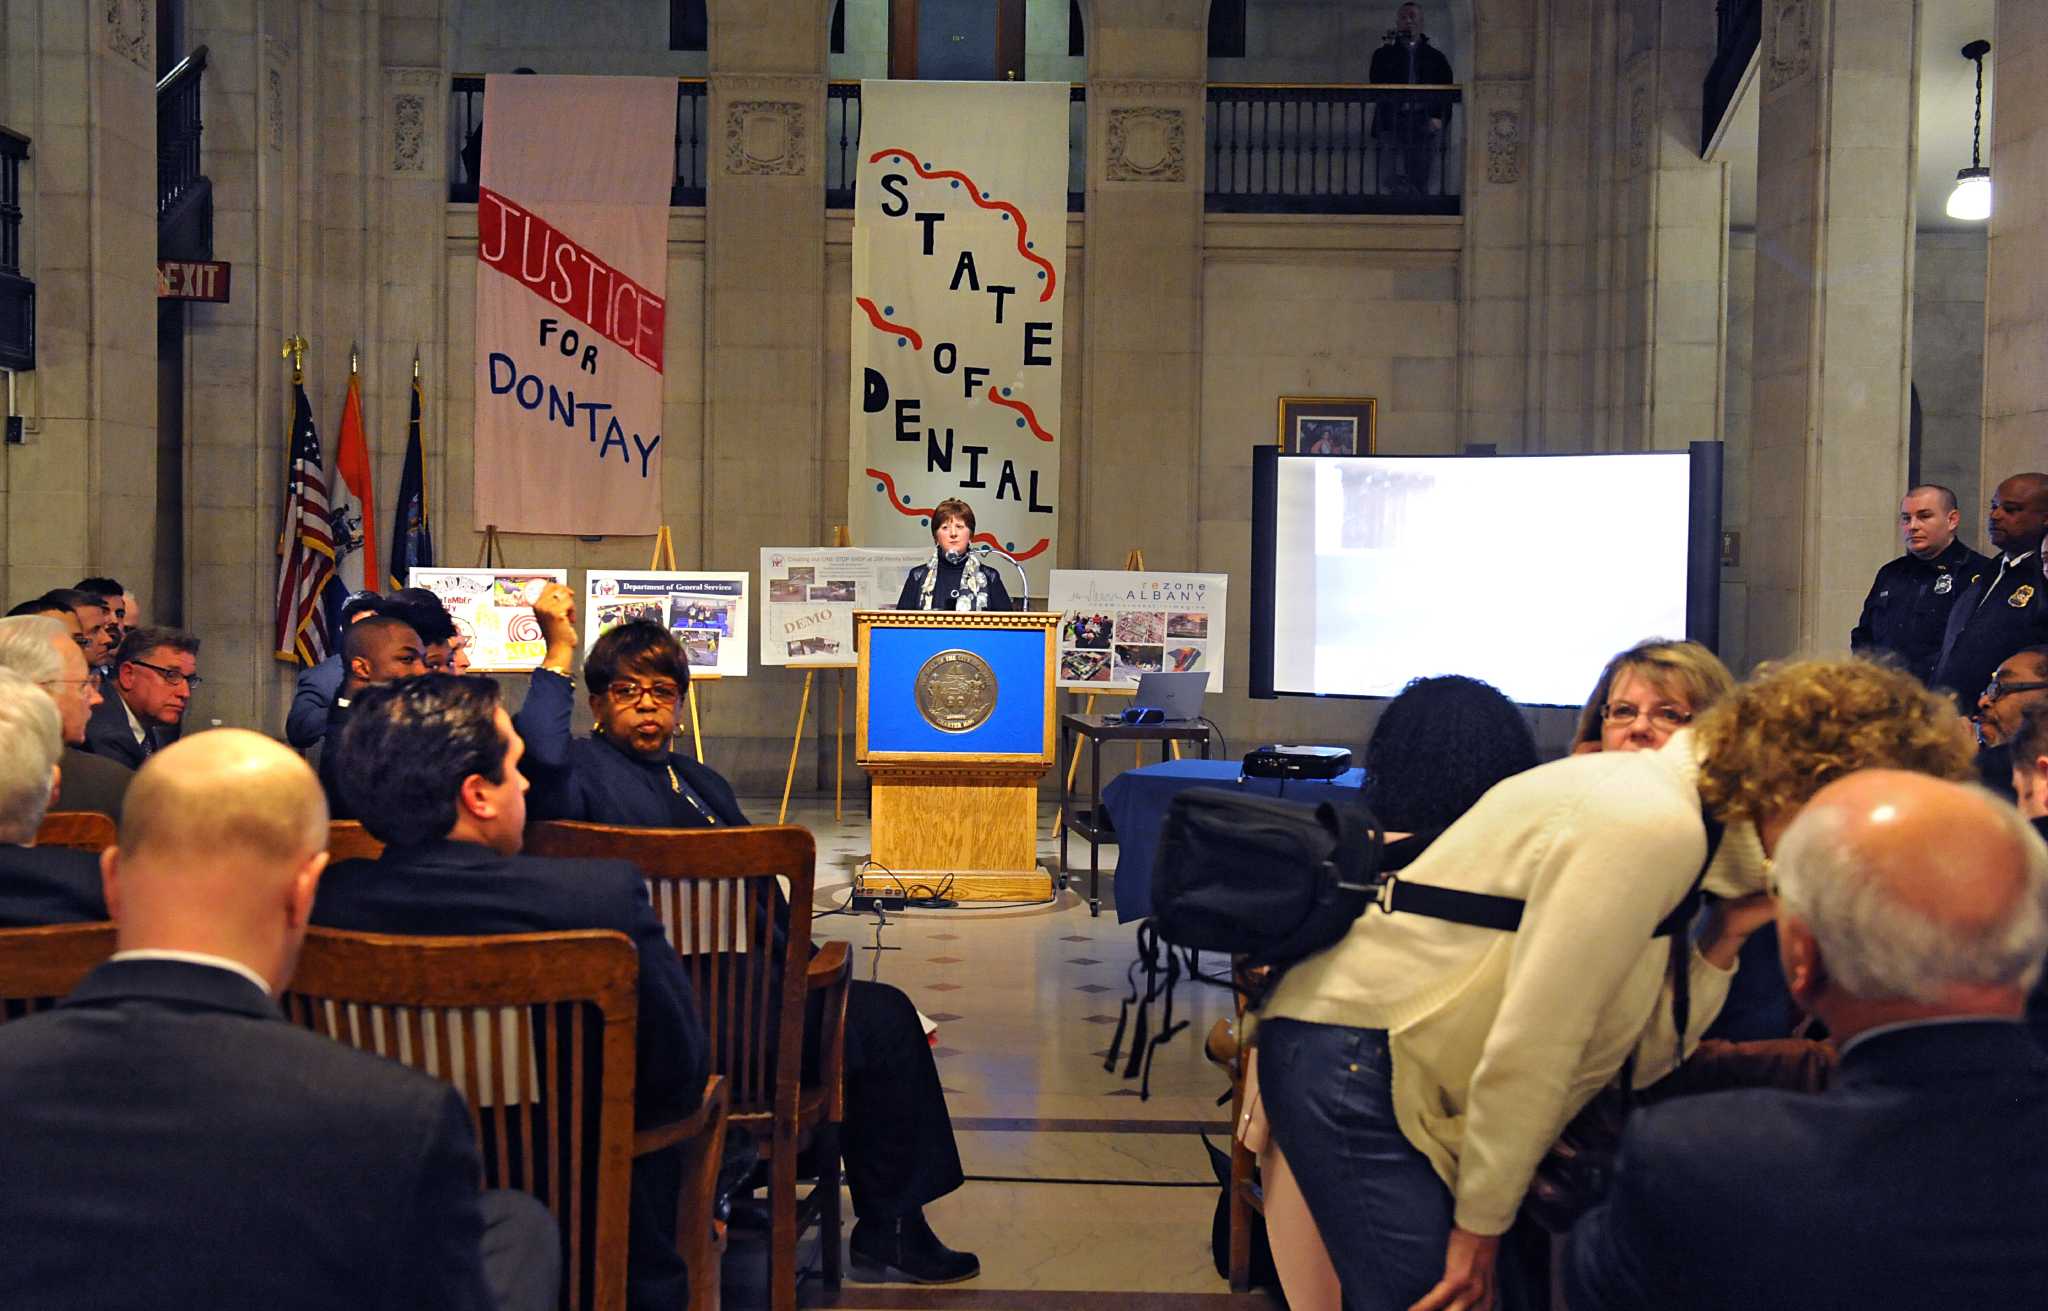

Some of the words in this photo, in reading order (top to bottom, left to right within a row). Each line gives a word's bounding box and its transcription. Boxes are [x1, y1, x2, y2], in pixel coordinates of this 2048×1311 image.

[165, 263, 220, 297] EXIT
[482, 194, 662, 368] JUSTICE
[881, 174, 1053, 366] STATE
[540, 319, 598, 375] FOR
[933, 342, 990, 398] OF
[489, 352, 661, 477] DONTAY
[863, 367, 1053, 513] DENIAL
[623, 583, 665, 591] Department
[1126, 590, 1205, 600] ALBANY
[1142, 581, 1206, 590] rezone
[784, 609, 832, 633] DEMO
